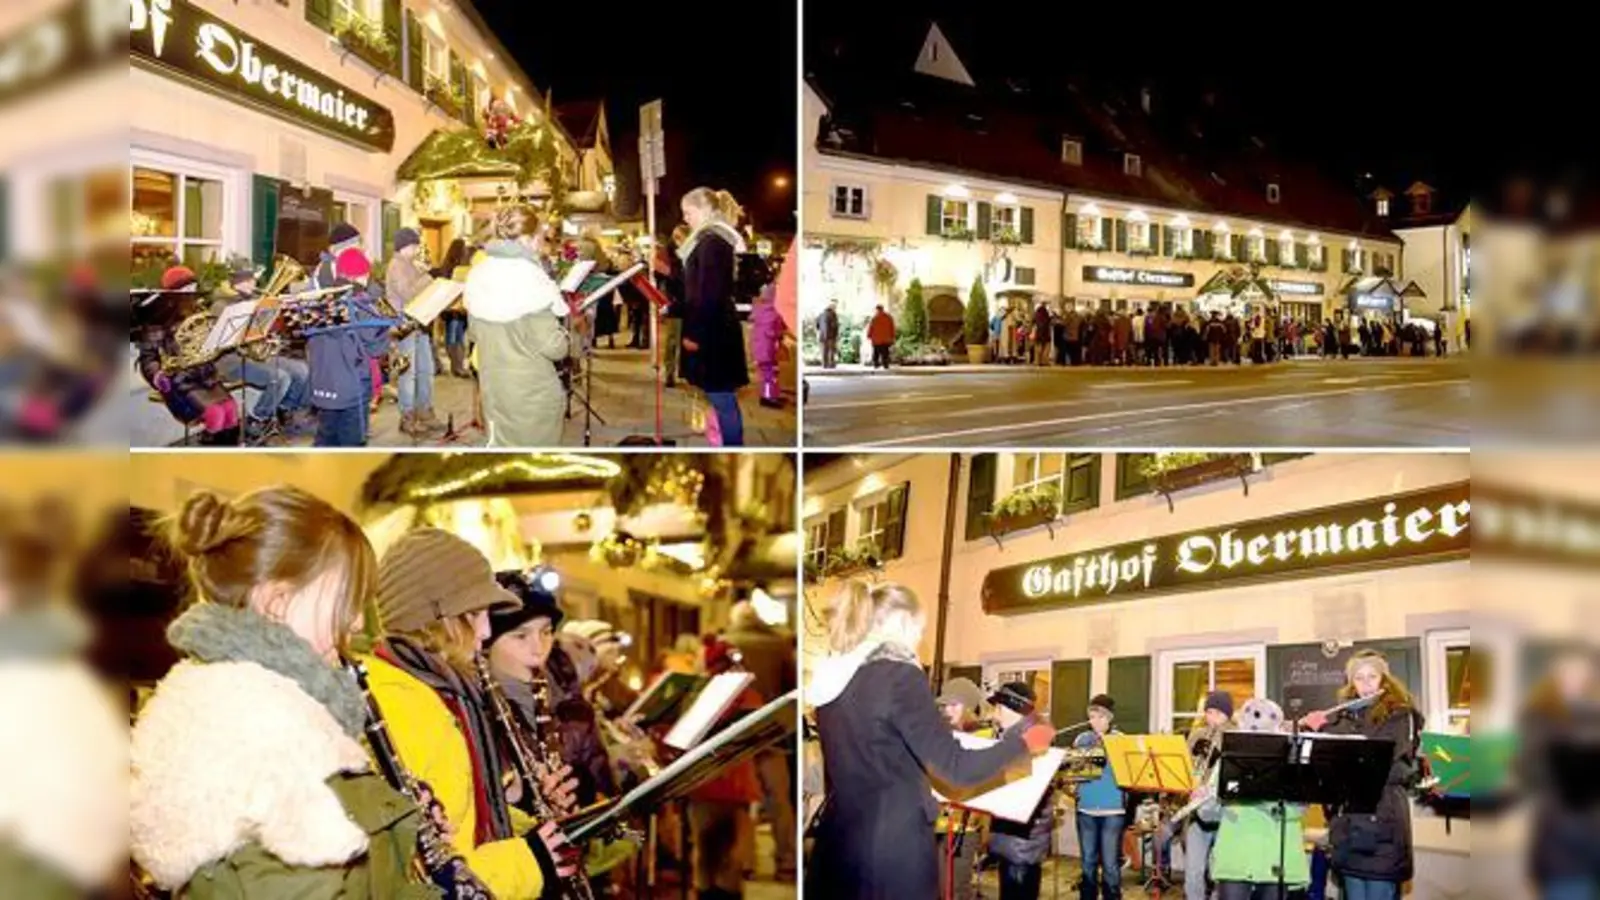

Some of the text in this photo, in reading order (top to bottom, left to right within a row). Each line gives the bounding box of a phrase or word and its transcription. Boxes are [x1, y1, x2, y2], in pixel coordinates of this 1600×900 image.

[194, 23, 368, 130] Obermaier
[1022, 499, 1470, 599] Gasthof Obermaier
